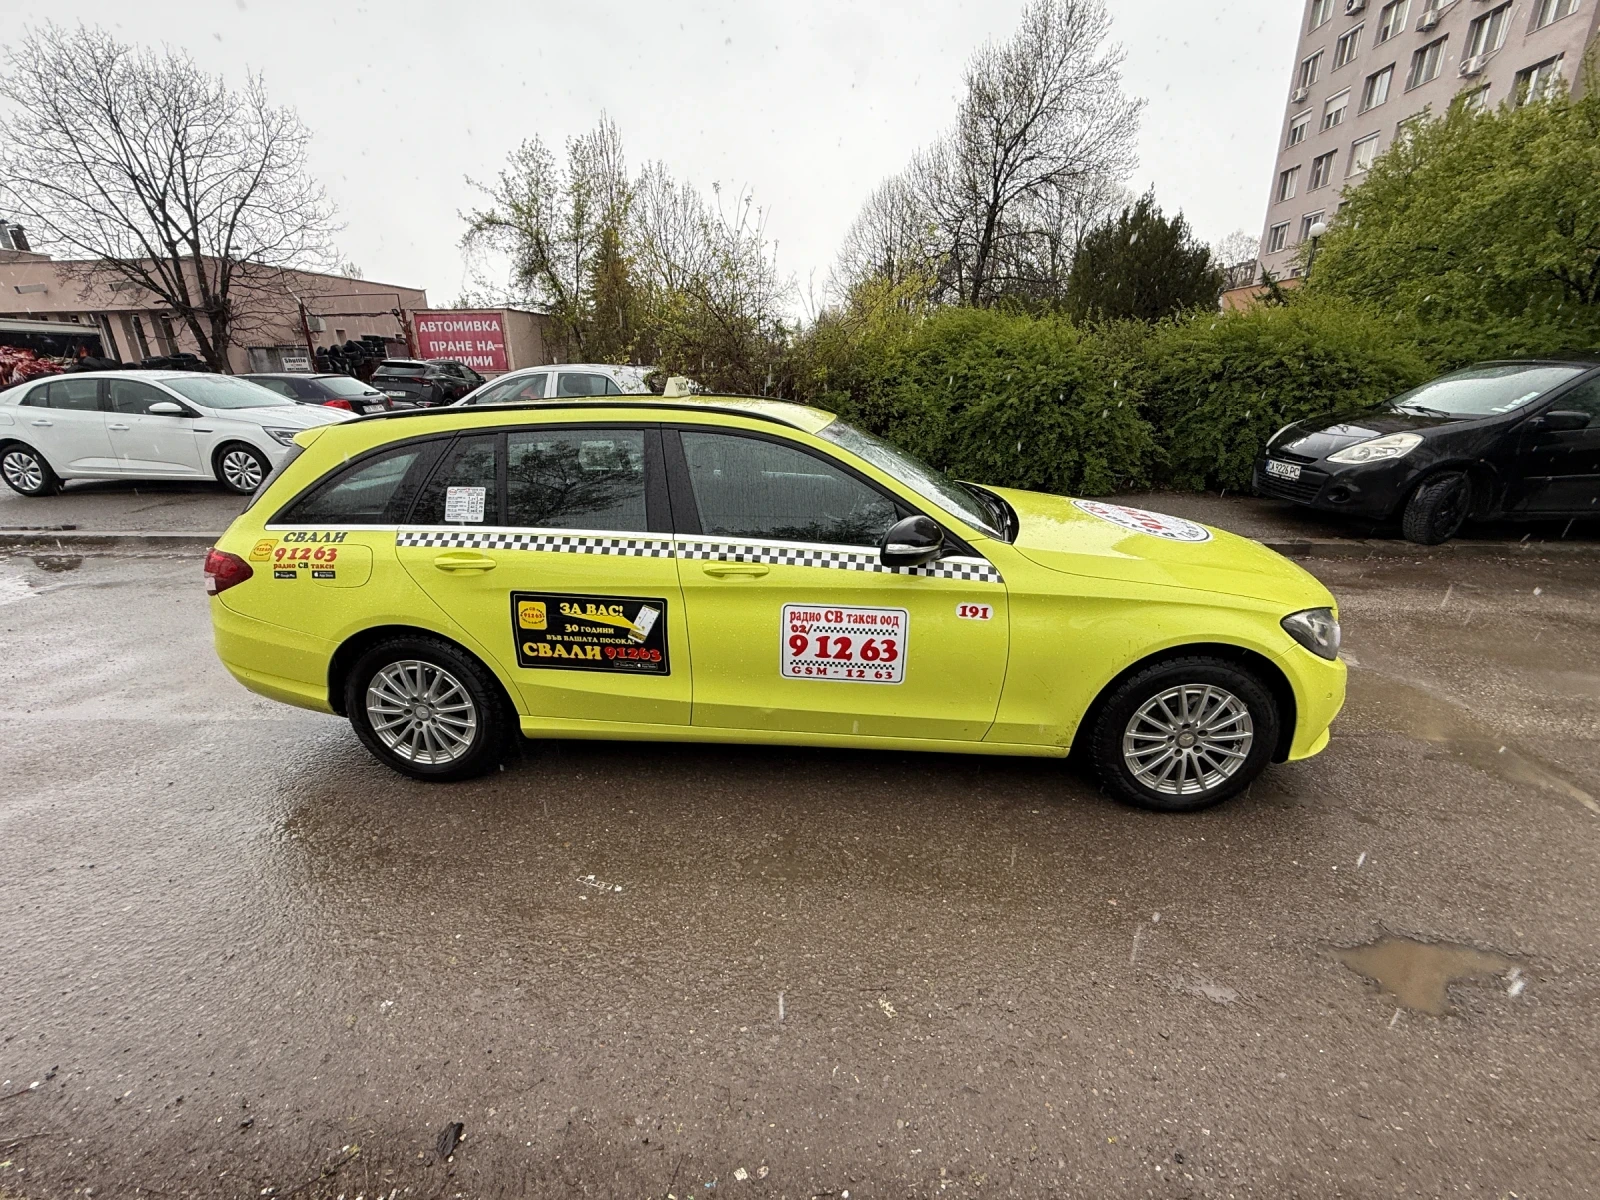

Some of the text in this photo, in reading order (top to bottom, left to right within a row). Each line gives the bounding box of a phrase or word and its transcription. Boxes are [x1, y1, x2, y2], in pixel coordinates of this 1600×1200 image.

[420, 321, 500, 332] АВТОМИВКА
[429, 341, 473, 351] ПРАНЕ
[283, 532, 348, 542] СВАЛИ
[559, 603, 624, 616] ЗА ВАС!
[958, 605, 989, 619] 191
[789, 610, 899, 629] радио СВ такси оод
[564, 624, 578, 632] 30
[564, 635, 598, 643] ВАШАТА
[522, 642, 662, 662] СВАЛИ 91263
[792, 666, 827, 675] GSM
